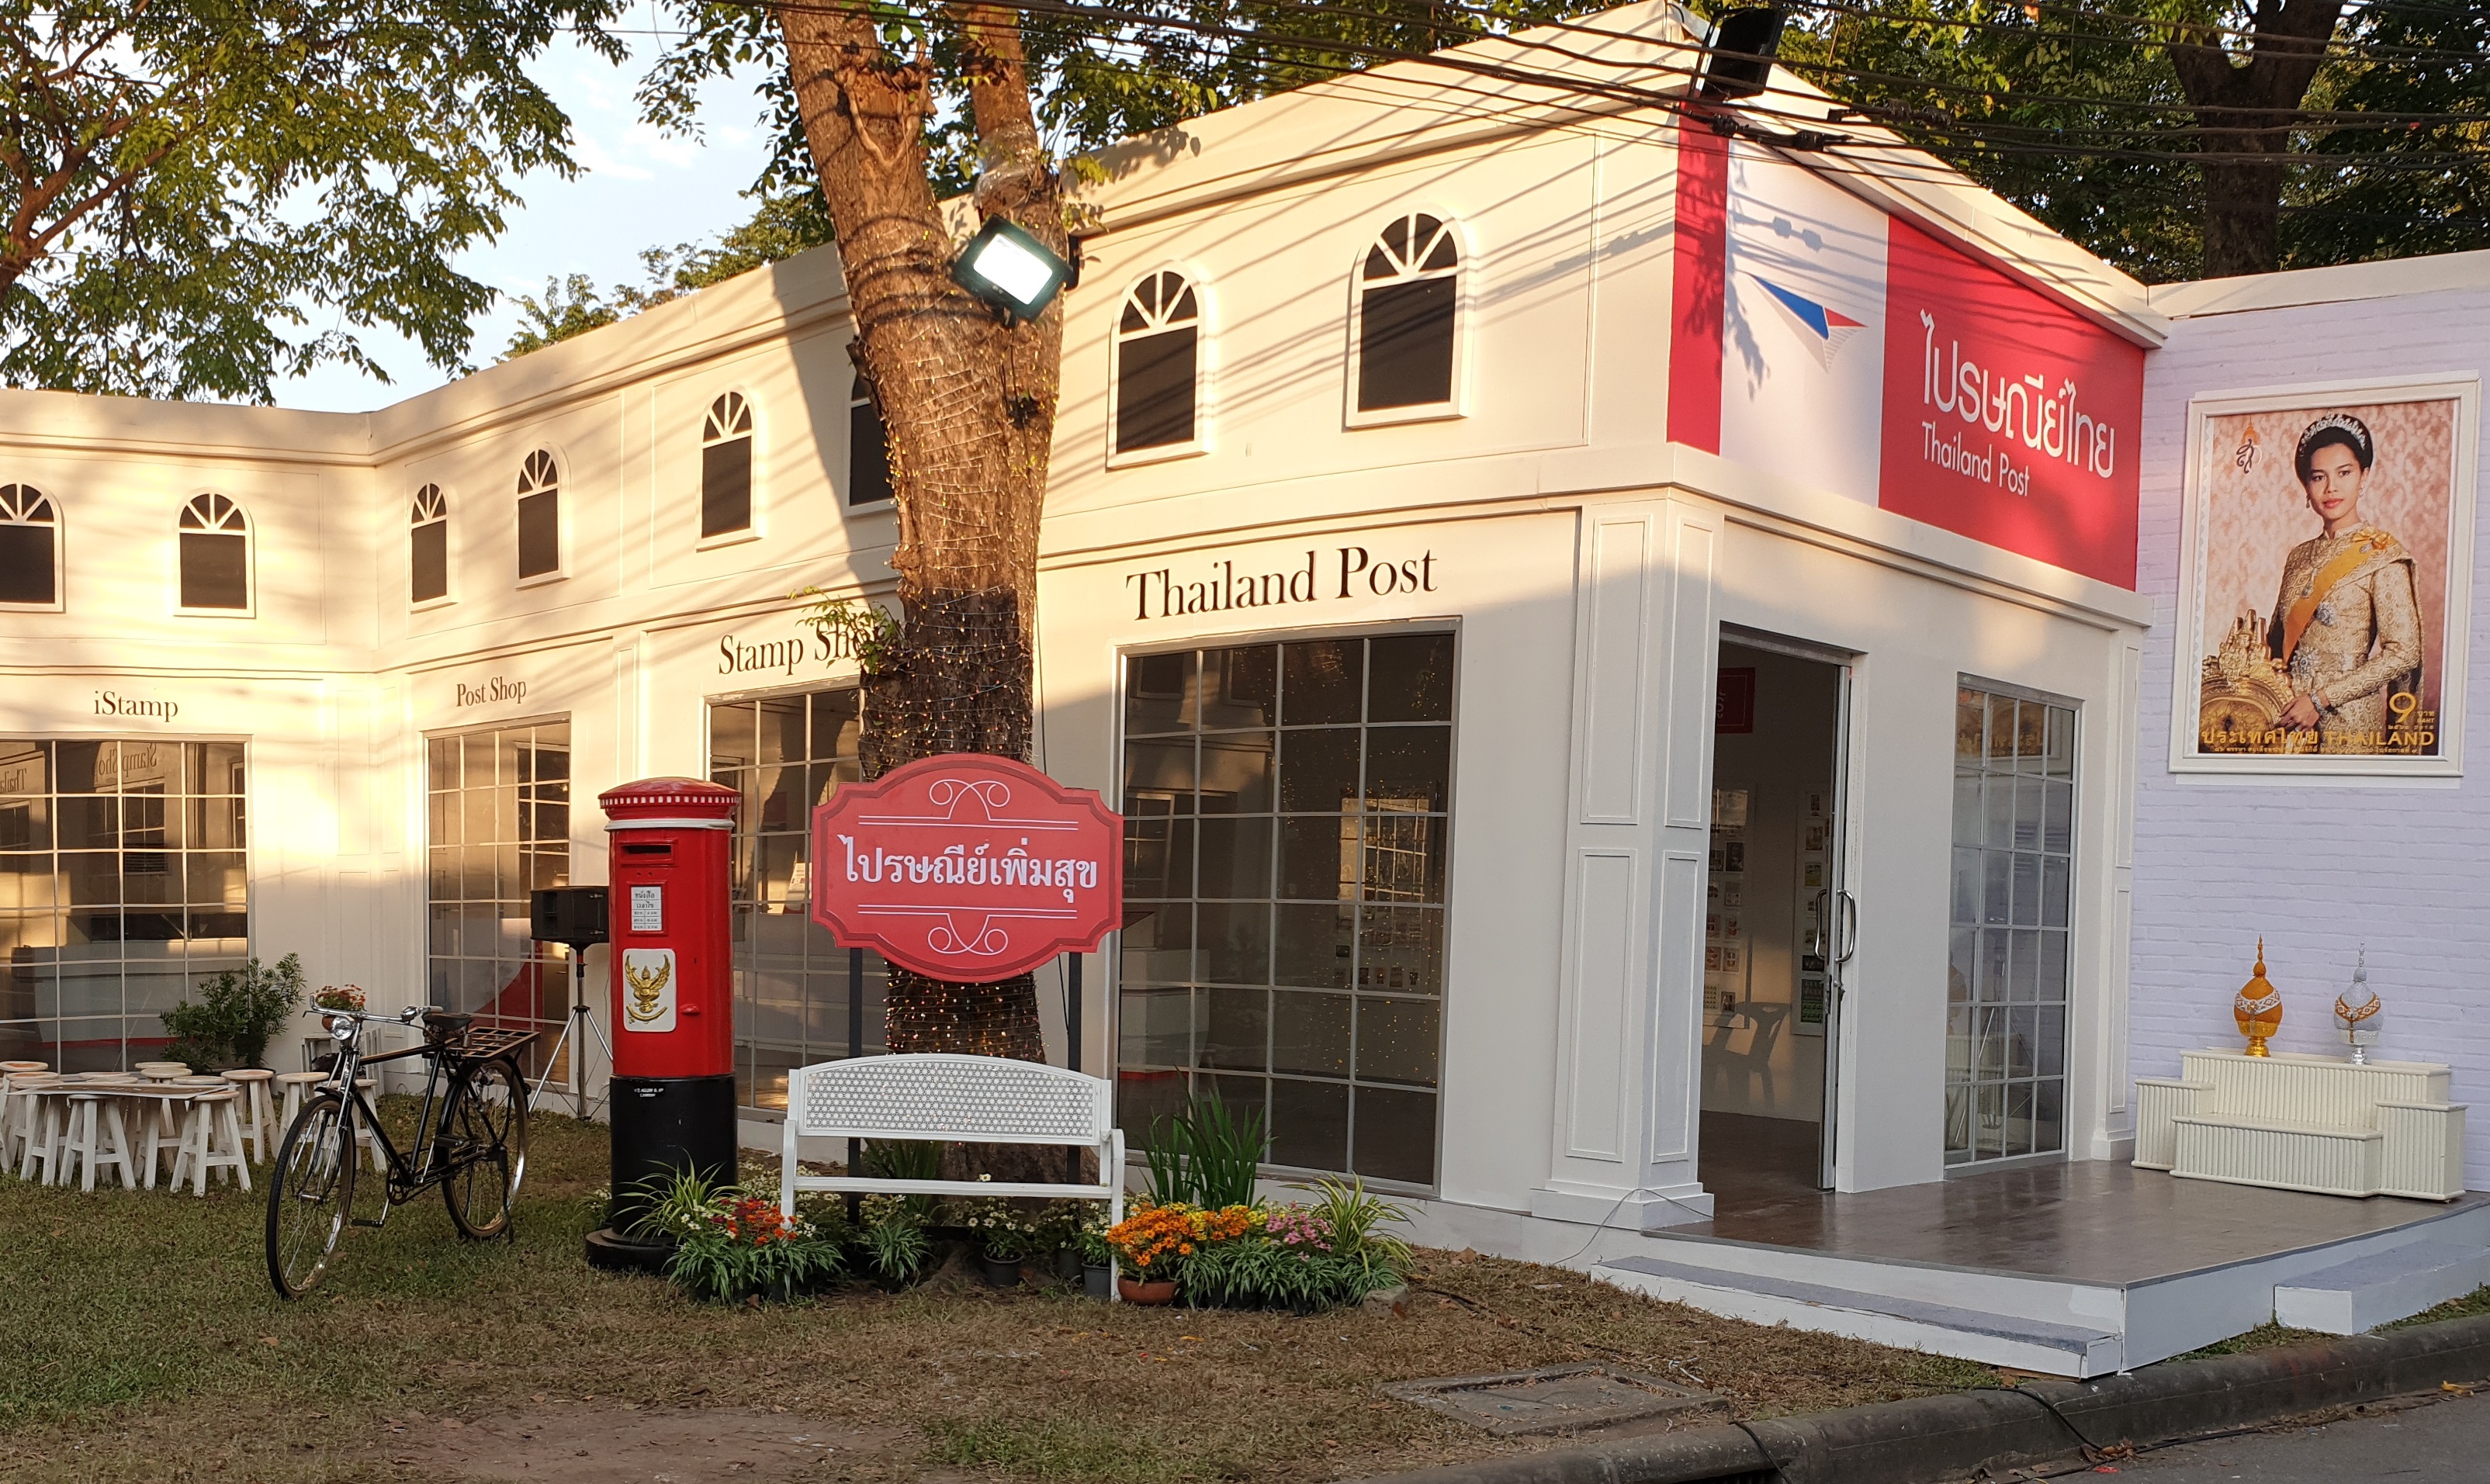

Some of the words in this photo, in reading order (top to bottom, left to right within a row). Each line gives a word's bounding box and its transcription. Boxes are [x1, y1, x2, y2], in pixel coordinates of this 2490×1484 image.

[1919, 308, 2115, 479] ไปรษณีย์ไทย
[1922, 420, 1993, 483] Thailand
[1998, 452, 2030, 496] Post
[1125, 550, 1318, 621] Thailand
[1335, 546, 1438, 599] Post
[719, 635, 804, 676] Stamp
[94, 690, 178, 722] iStamp
[456, 683, 487, 707] Post
[490, 676, 526, 704] Shop
[2201, 727, 2319, 744] ประเทศไทย
[2323, 731, 2435, 746] THAILAND
[837, 833, 1098, 904] ไปรษณีย์เพิ่มสุข
